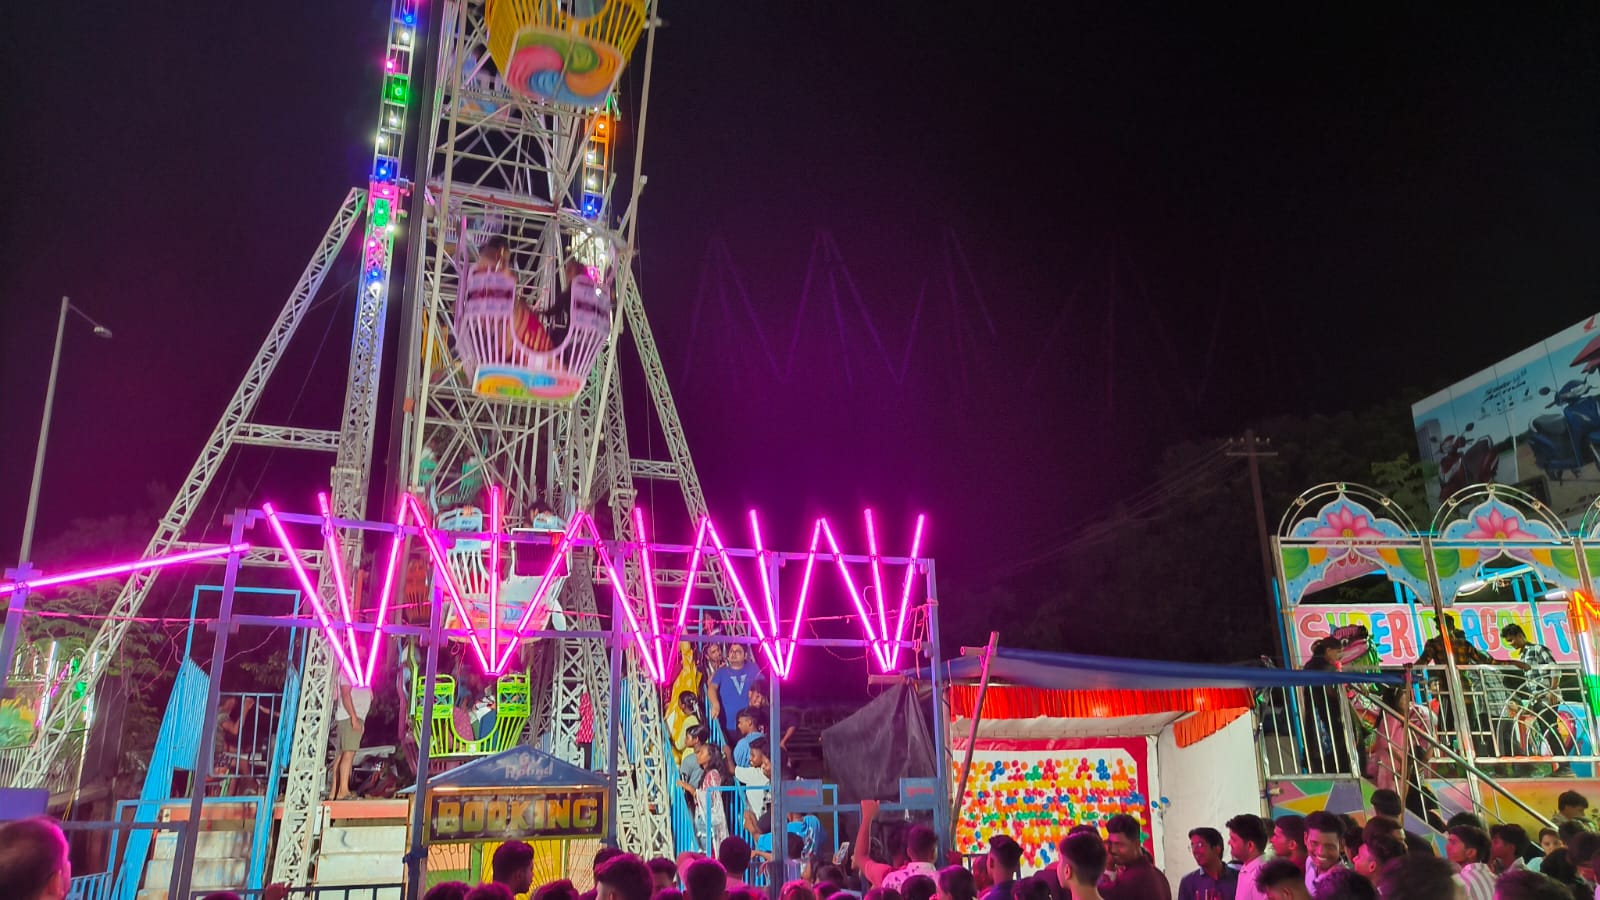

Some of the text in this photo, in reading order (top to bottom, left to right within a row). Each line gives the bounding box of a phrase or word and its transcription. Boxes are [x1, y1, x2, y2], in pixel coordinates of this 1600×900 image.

[1419, 607, 1535, 660] DAGON
[729, 673, 748, 696] V
[436, 798, 599, 834] BOOKING
